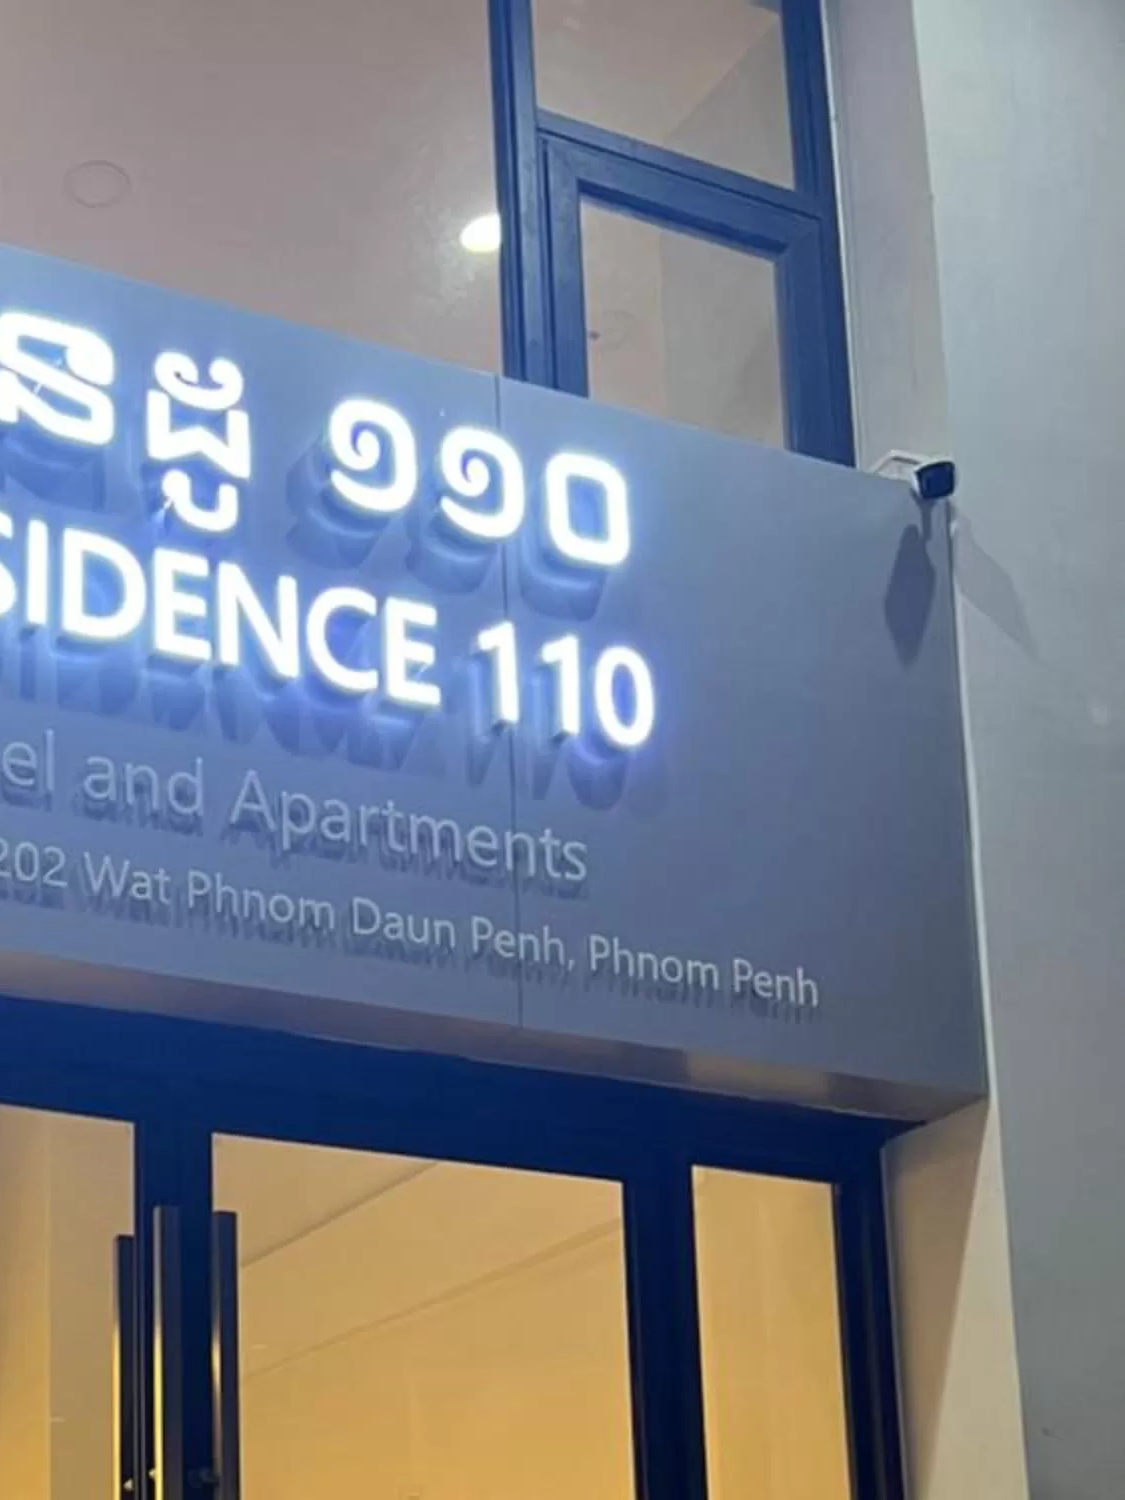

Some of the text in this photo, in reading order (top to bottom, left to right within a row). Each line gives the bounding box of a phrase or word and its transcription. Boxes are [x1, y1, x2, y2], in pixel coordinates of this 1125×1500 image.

[328, 398, 632, 566] ១១០
[478, 621, 656, 749] 110
[83, 755, 204, 815] and
[229, 768, 589, 882] Apartments
[82, 851, 171, 905] Wat
[186, 870, 335, 931] Phnom
[352, 897, 456, 949] Daun
[473, 915, 575, 972] Penh,
[589, 934, 720, 991] Phnom
[733, 957, 819, 1007] Penh
